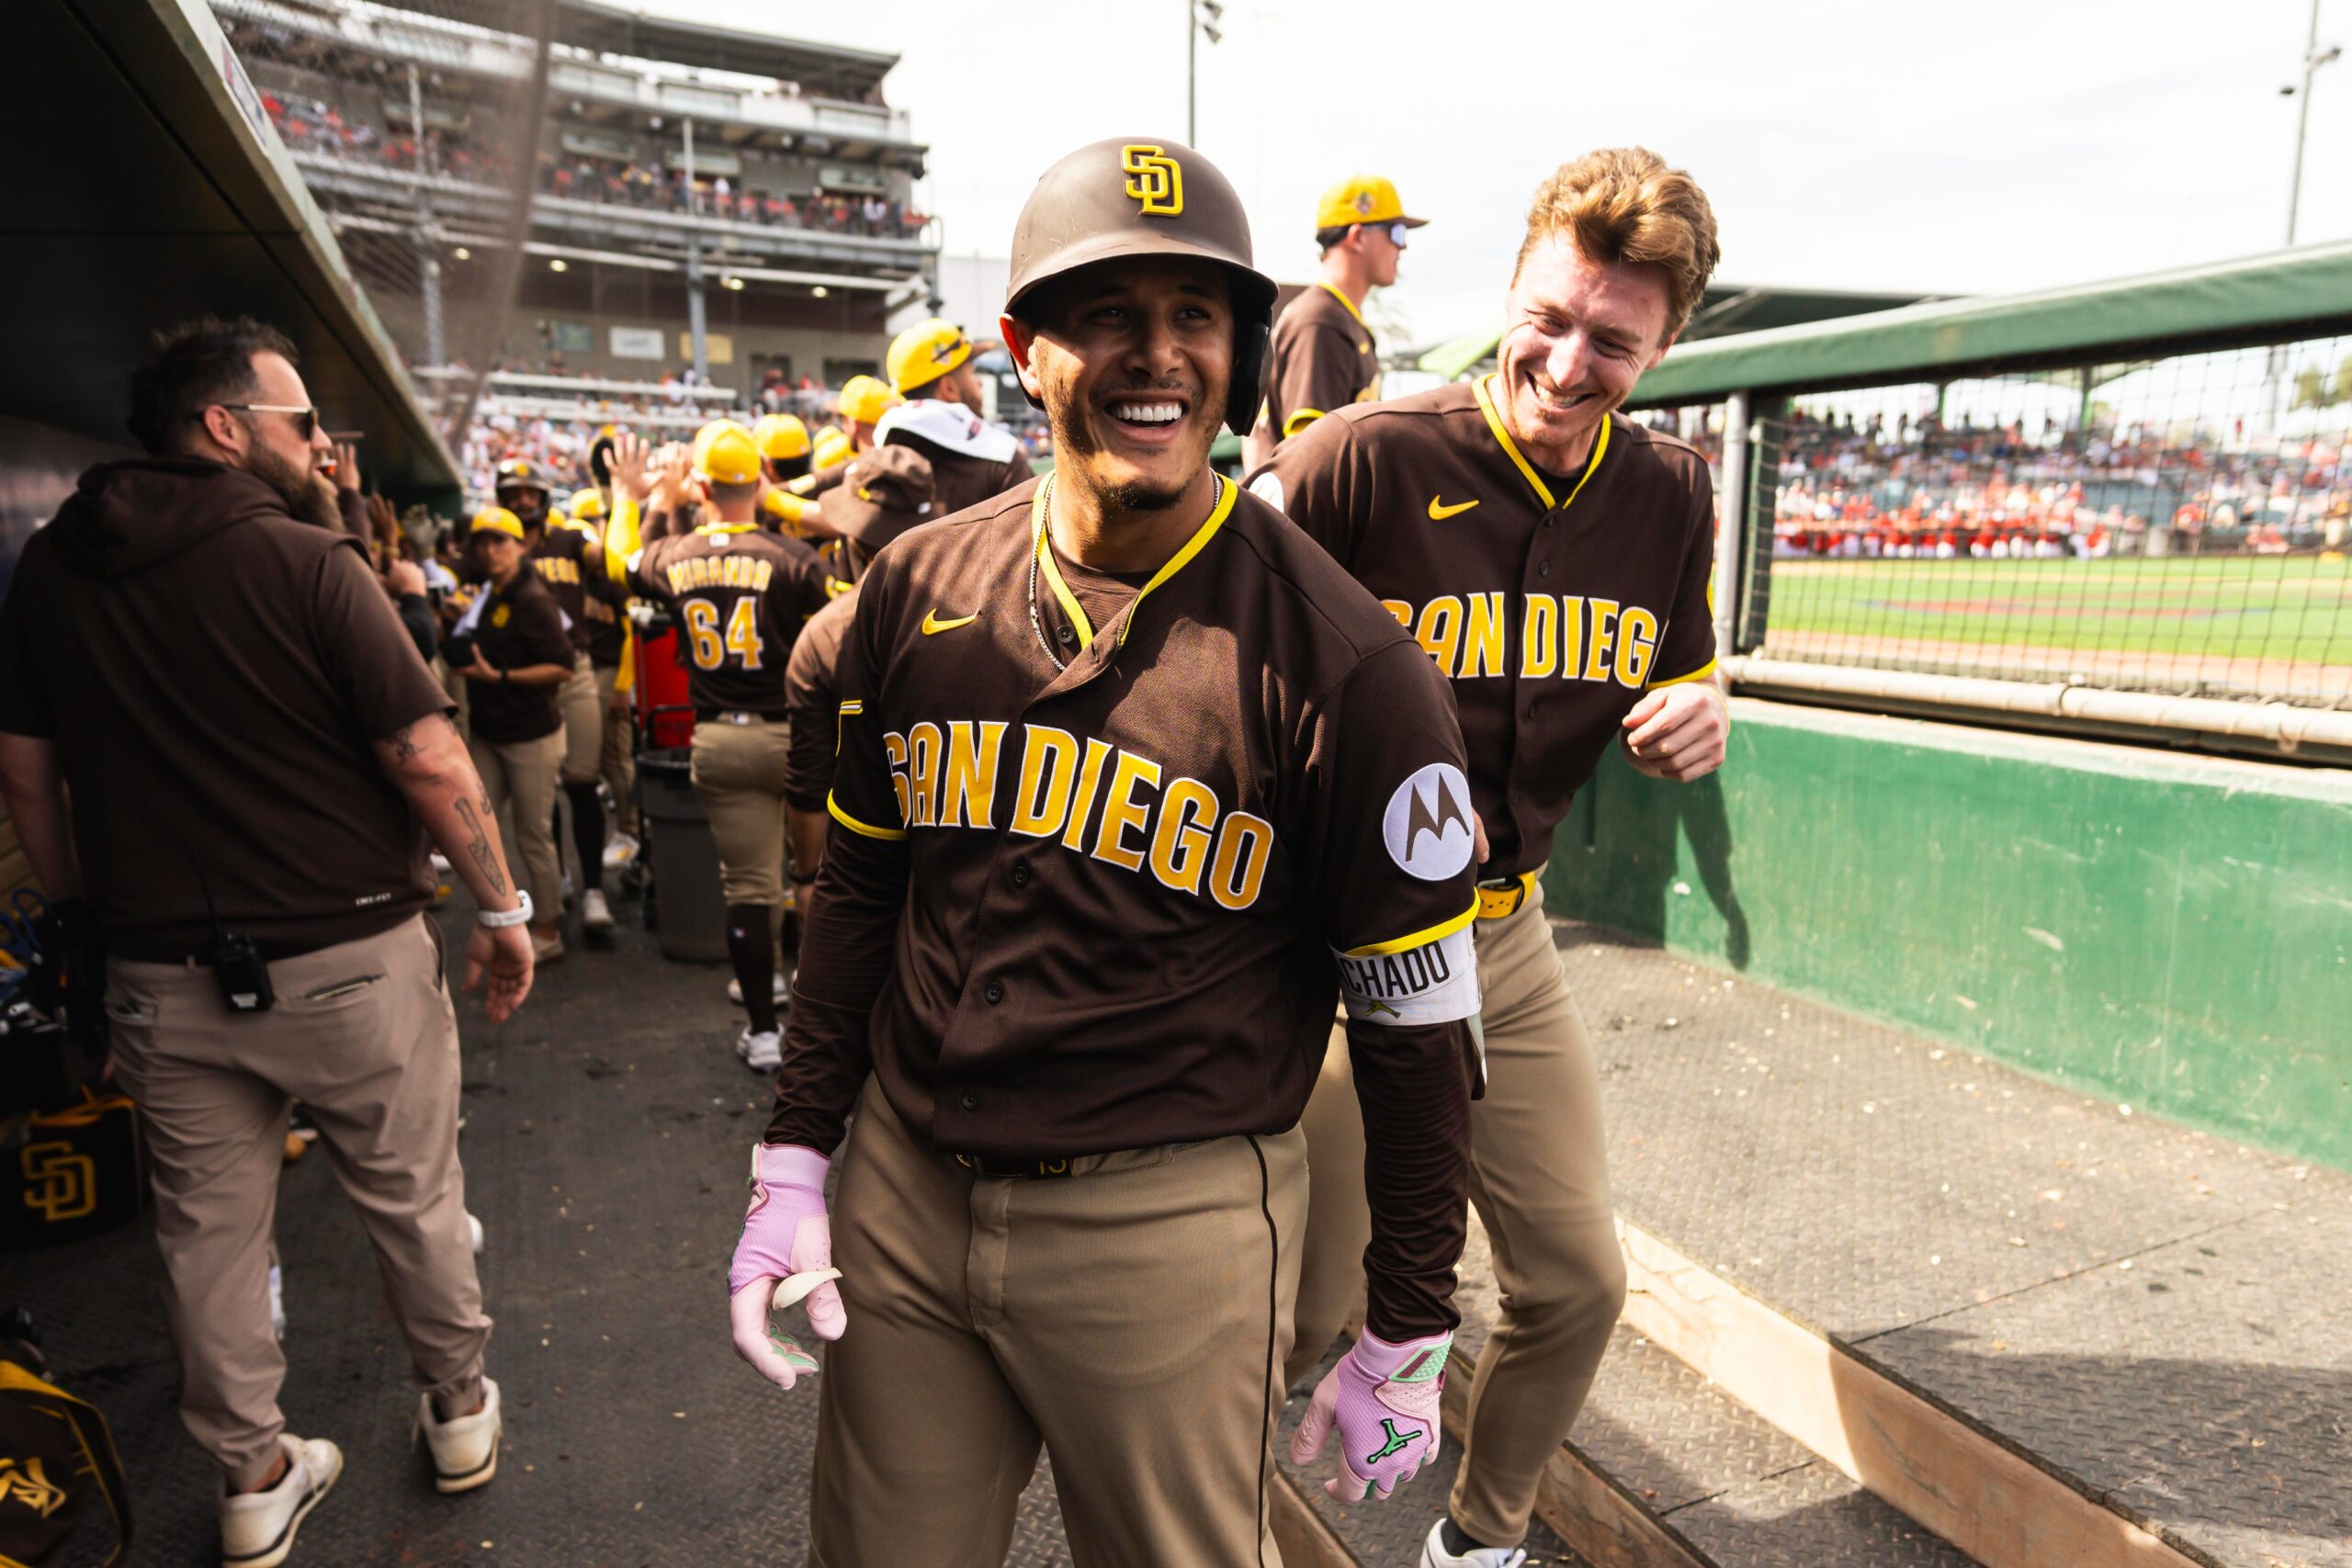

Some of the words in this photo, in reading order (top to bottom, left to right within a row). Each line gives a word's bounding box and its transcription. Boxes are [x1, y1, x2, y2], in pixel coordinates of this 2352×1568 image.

[1121, 144, 1183, 216] SD
[683, 596, 763, 671] 64
[1520, 592, 1669, 689] DIEG
[1010, 723, 1274, 910] DIEGO
[1337, 941, 1451, 998] CHADO
[22, 1140, 96, 1222] SD
